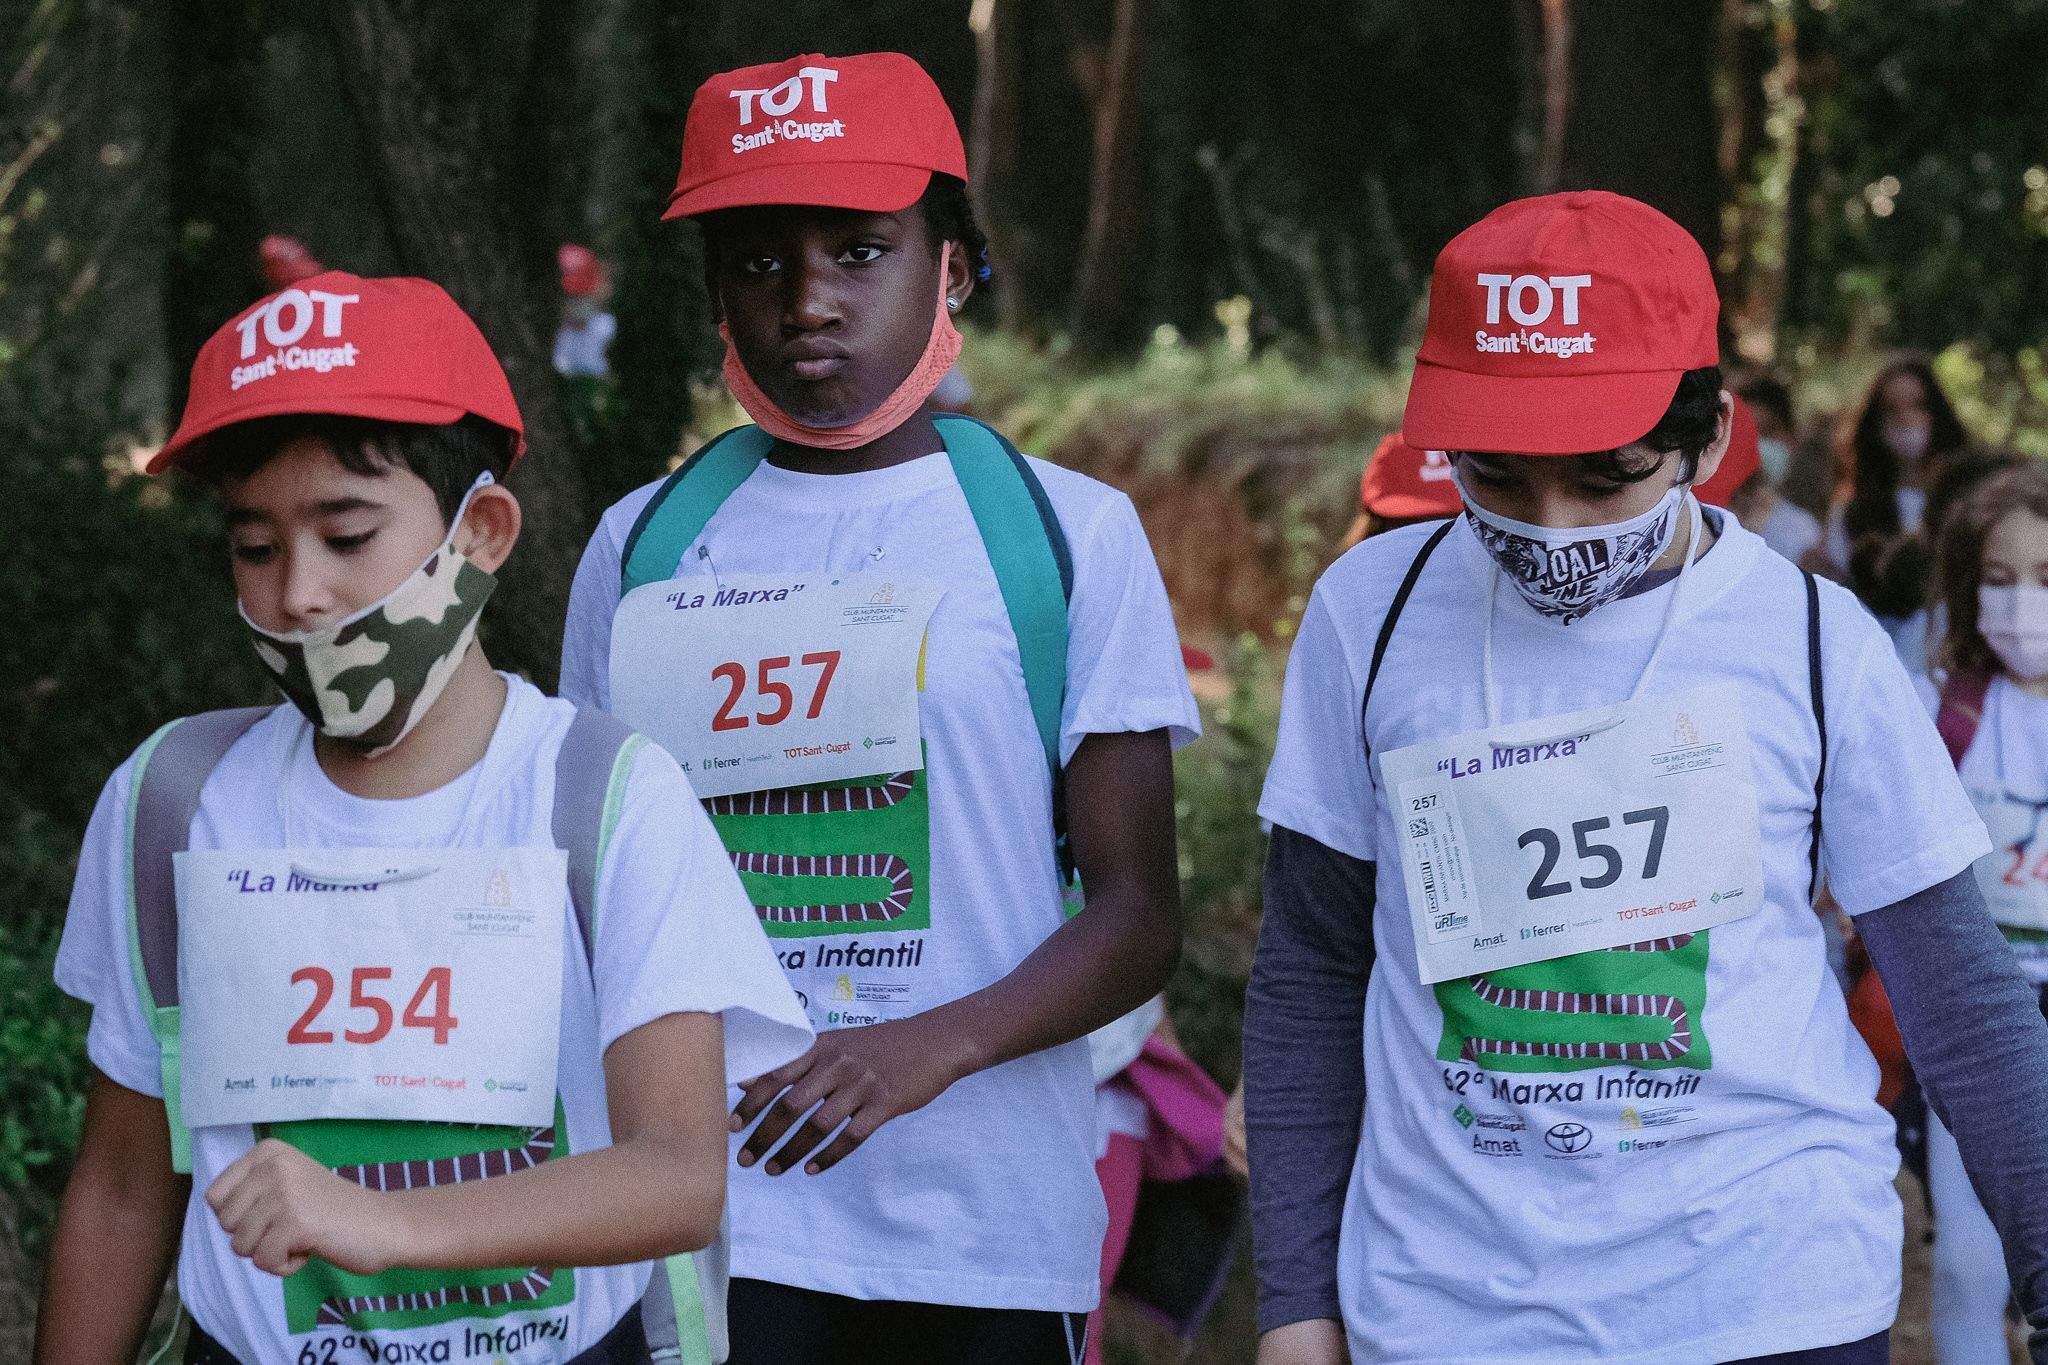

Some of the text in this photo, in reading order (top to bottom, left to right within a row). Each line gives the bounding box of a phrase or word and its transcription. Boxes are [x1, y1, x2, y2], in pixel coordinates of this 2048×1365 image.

[729, 66, 839, 125] TOT
[731, 118, 847, 154] Sant Cugat
[1477, 272, 1592, 326] TOT
[235, 288, 360, 360] TOT
[1475, 330, 1597, 358] Sant Cugat
[230, 342, 359, 391] Sant Cugat
[711, 649, 842, 732] 257
[714, 757, 742, 769] ferrer
[783, 747, 802, 759] TOT
[803, 745, 822, 757] Sant
[1411, 795, 1438, 811] 257
[1517, 805, 1671, 901] 257
[1616, 898, 1698, 921] TOT Sant Cugat
[1532, 923, 1566, 938] ferrer
[816, 938, 924, 968] Infantil
[286, 966, 459, 1046] 254
[842, 1011, 878, 1024] ferrer
[1489, 1077, 1585, 1105] Marxa
[1595, 1069, 1701, 1101] Infantil
